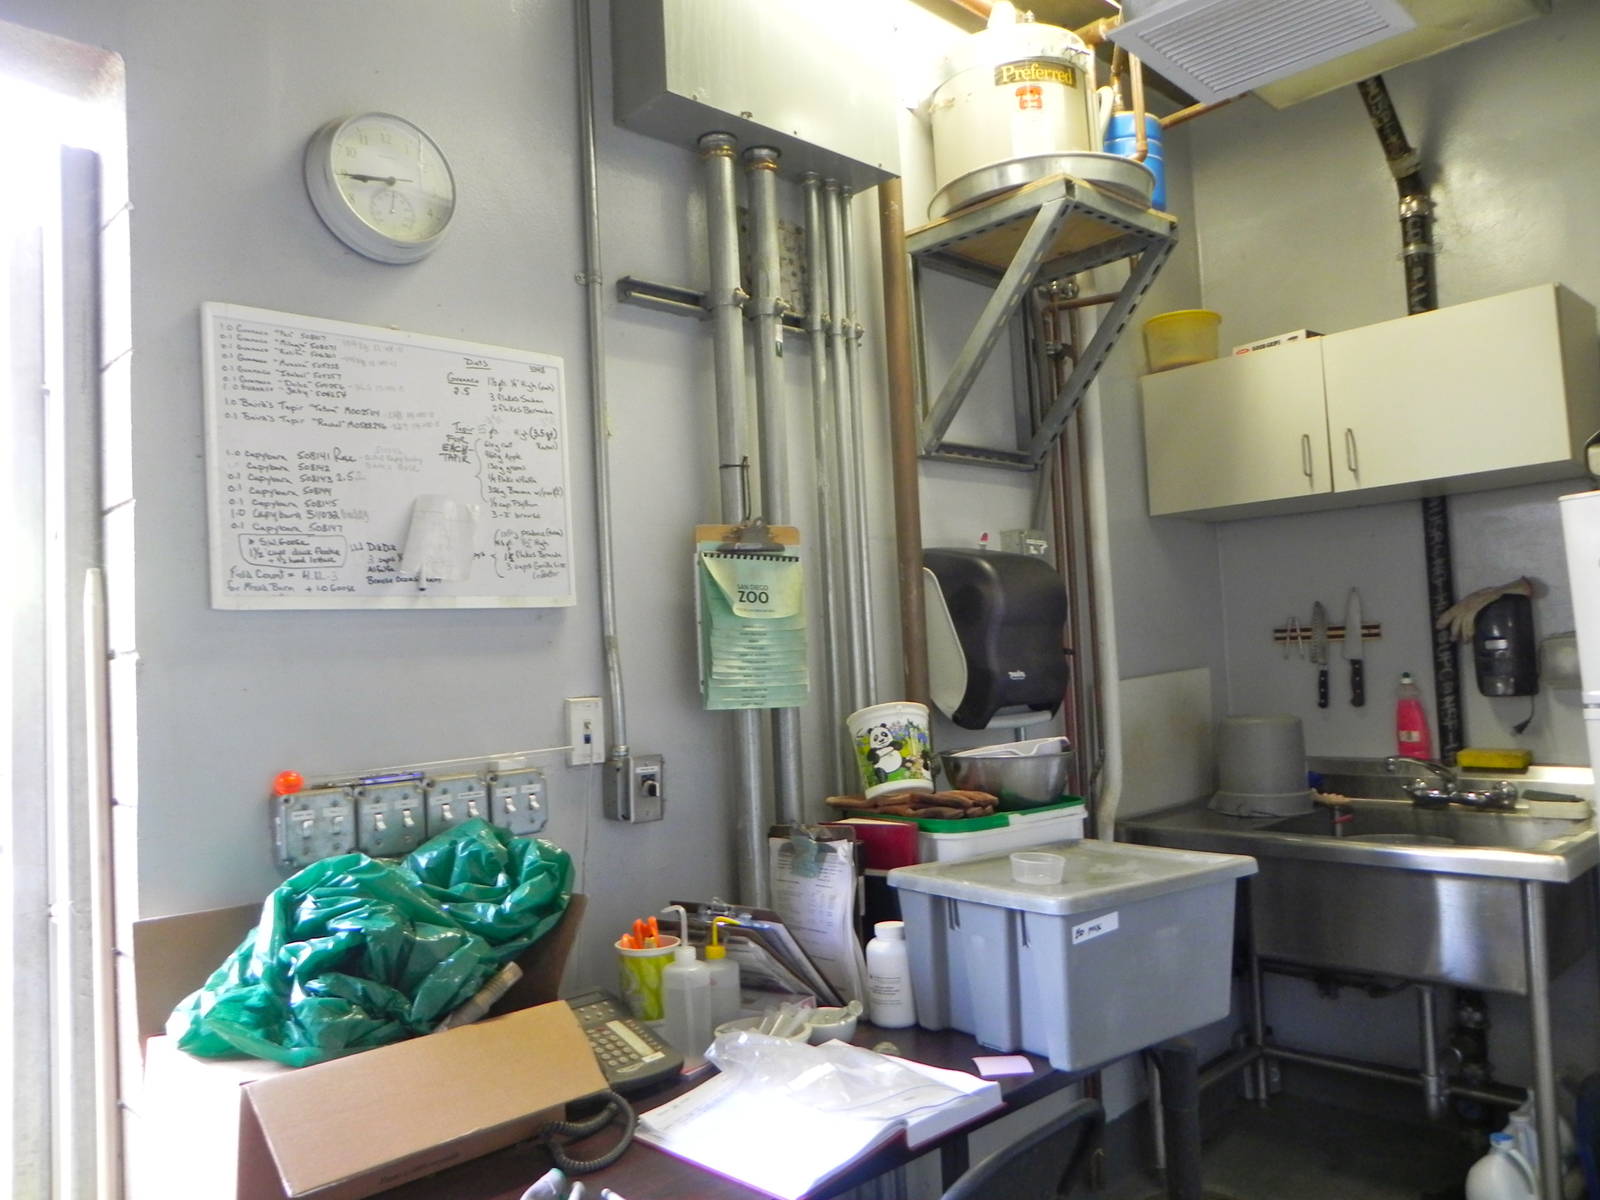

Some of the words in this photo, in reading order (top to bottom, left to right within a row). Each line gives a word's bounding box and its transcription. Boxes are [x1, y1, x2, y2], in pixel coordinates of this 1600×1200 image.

[1001, 63, 1073, 85] Preferred
[278, 401, 304, 413] Tapir
[279, 415, 304, 425] Tapir
[252, 509, 301, 522] Capybara
[738, 591, 769, 604] ZOO
